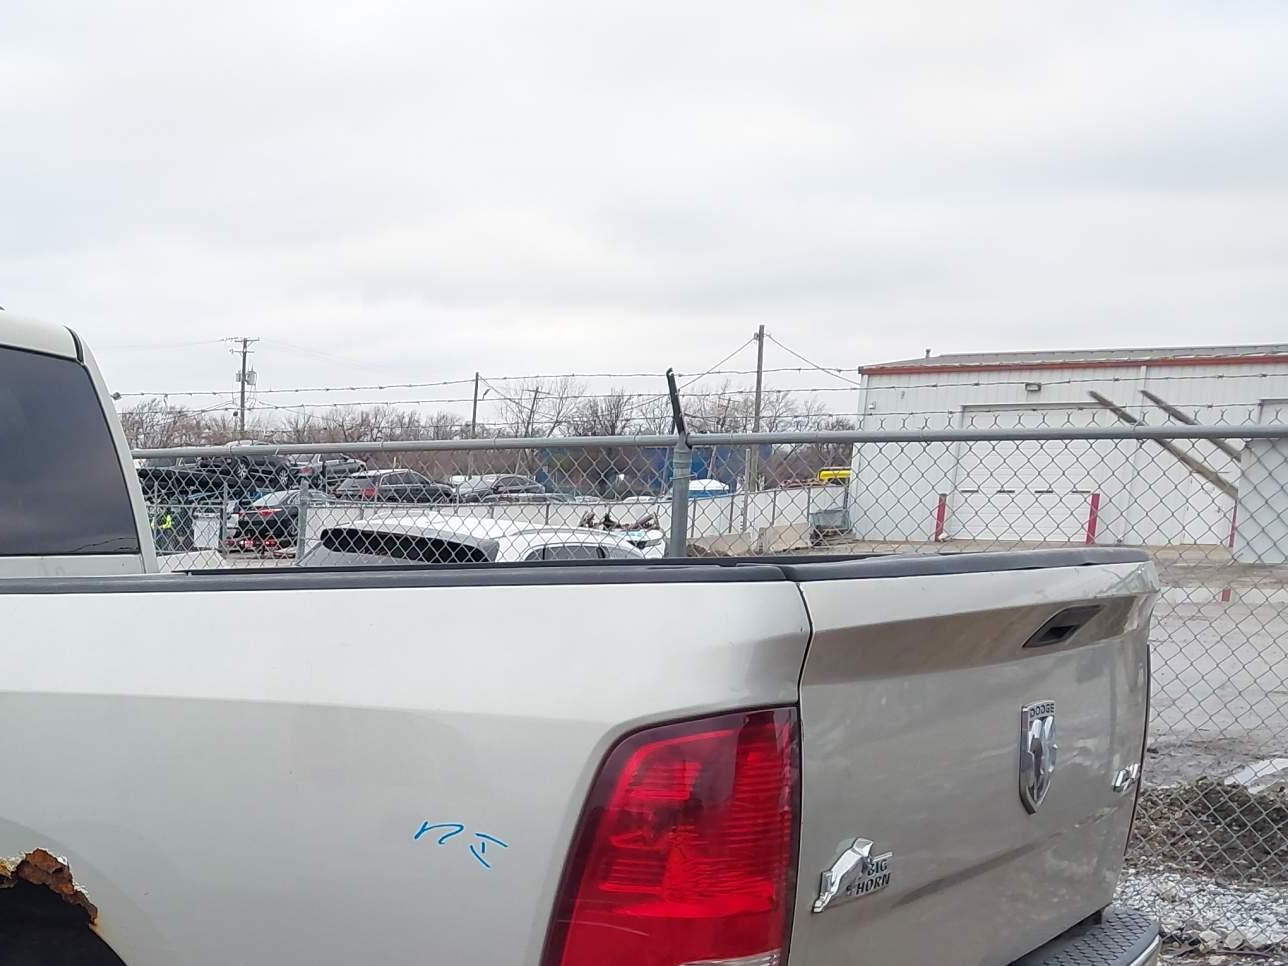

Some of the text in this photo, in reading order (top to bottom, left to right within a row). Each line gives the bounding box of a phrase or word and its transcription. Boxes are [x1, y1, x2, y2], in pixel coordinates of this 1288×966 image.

[1030, 703, 1055, 718] DODGE
[867, 859, 888, 877] BIG
[855, 872, 892, 897] HORN
